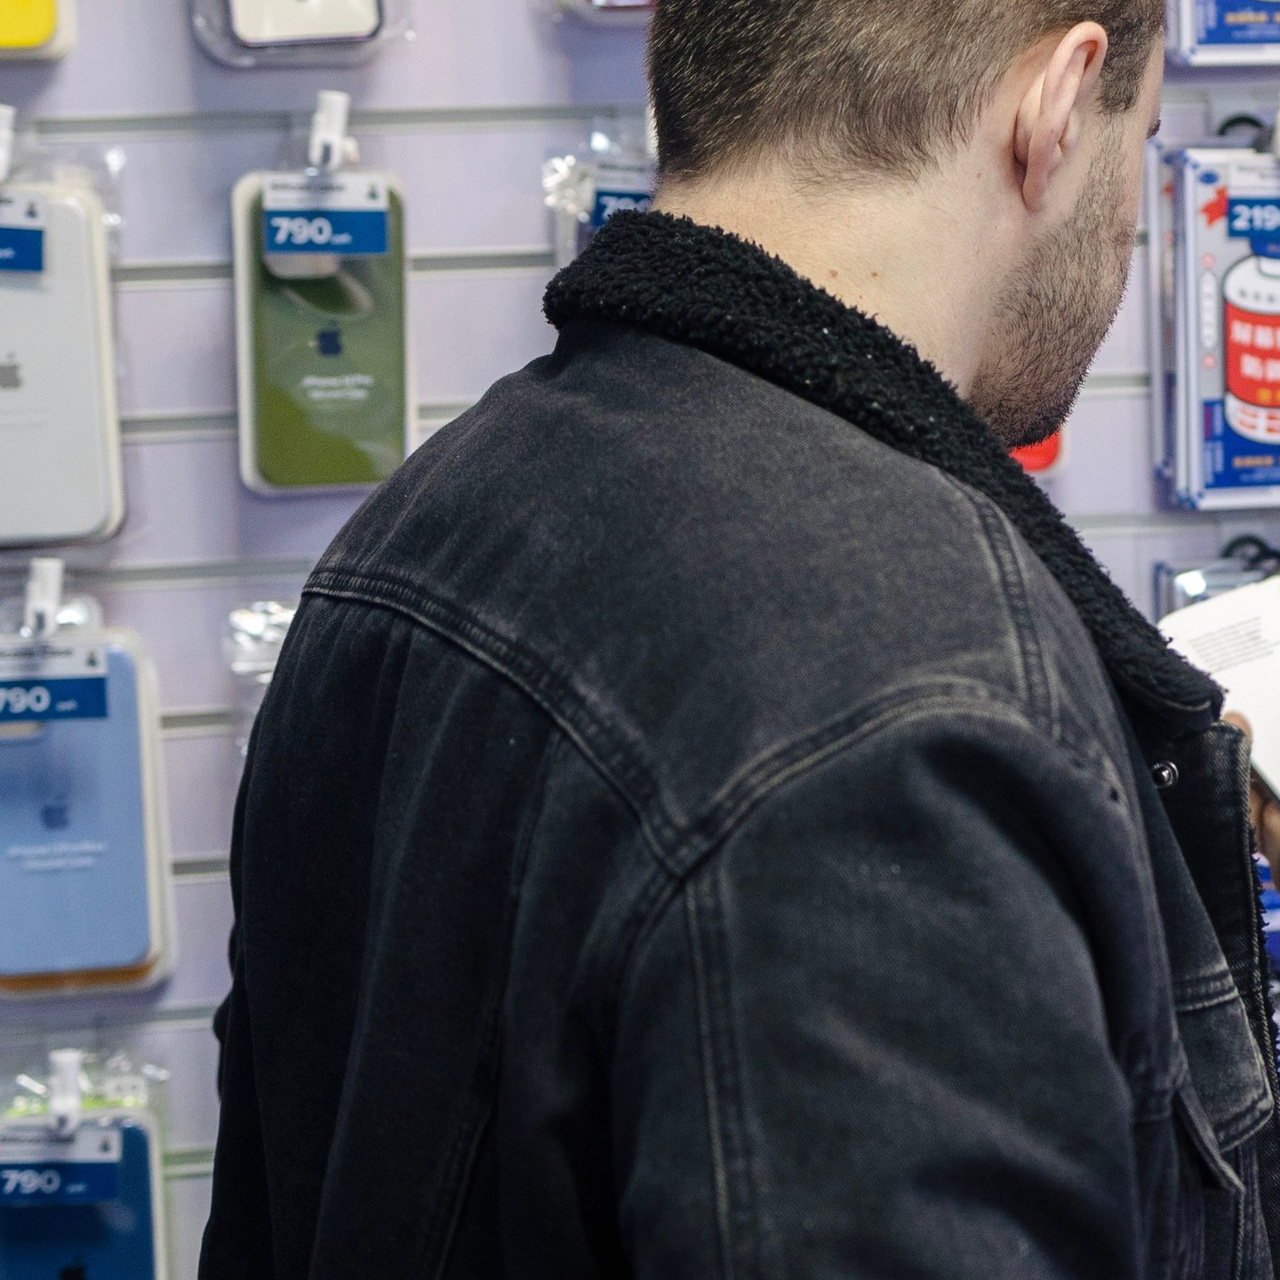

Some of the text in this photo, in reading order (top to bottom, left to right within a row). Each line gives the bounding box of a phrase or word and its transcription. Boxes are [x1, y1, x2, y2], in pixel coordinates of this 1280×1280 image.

[270, 216, 332, 245] 790
[0, 685, 51, 714] 90
[1, 1169, 61, 1195] 790
